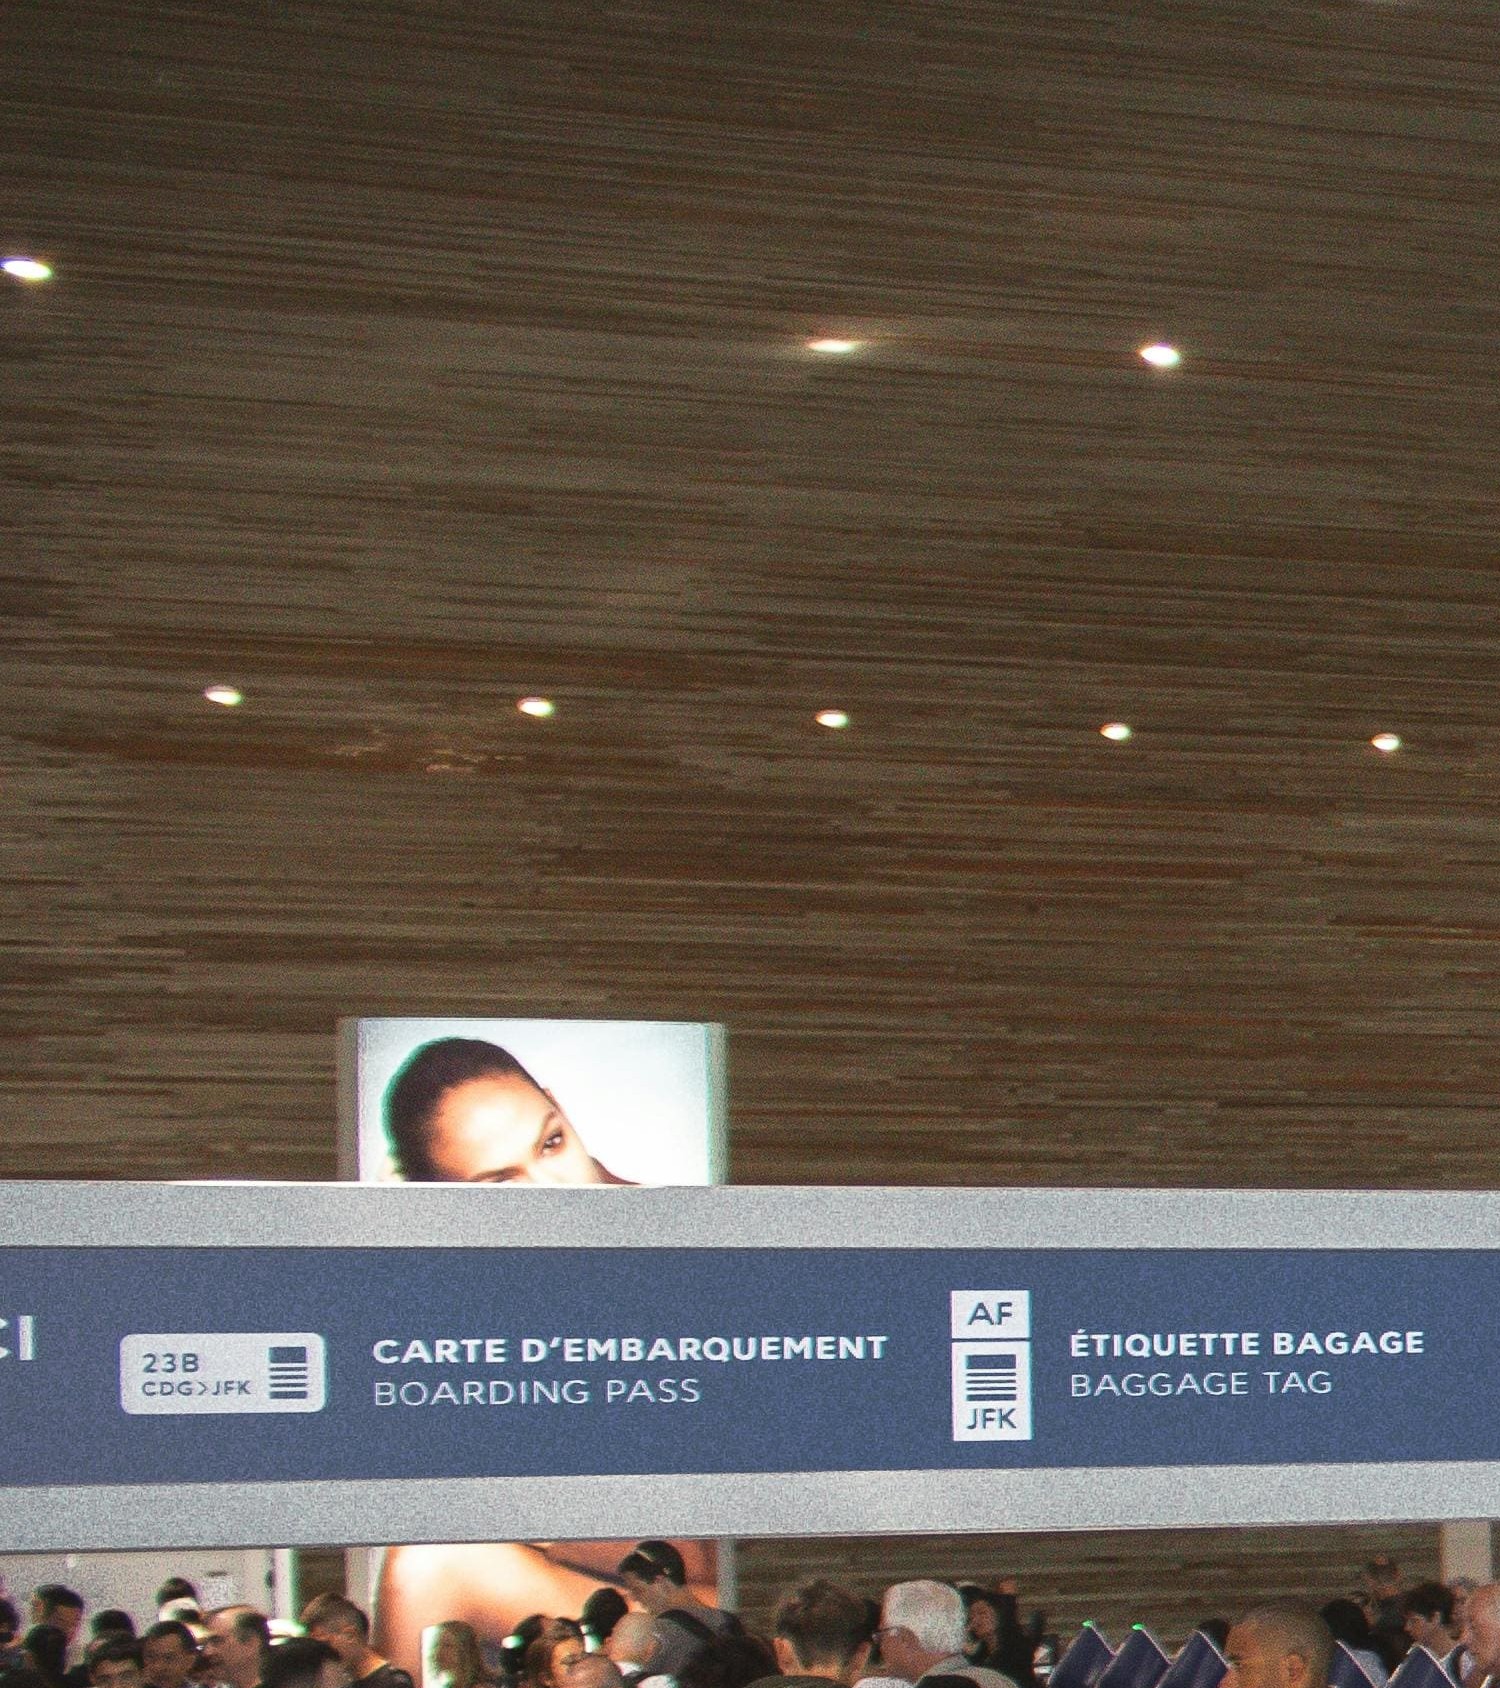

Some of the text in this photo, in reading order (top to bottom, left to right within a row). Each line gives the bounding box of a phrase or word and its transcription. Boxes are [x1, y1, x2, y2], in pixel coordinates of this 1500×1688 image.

[967, 1302, 1014, 1326] AF
[373, 1335, 889, 1364] CARTE D'EMBARQUEMENT
[1070, 1328, 1424, 1358] ÉTIQUETTE BAGAGE
[142, 1352, 200, 1373] 23B
[374, 1377, 702, 1408] BOARDING PASS
[1070, 1370, 1333, 1398] BAGGAGE TAG
[966, 1408, 1018, 1431] JFK
